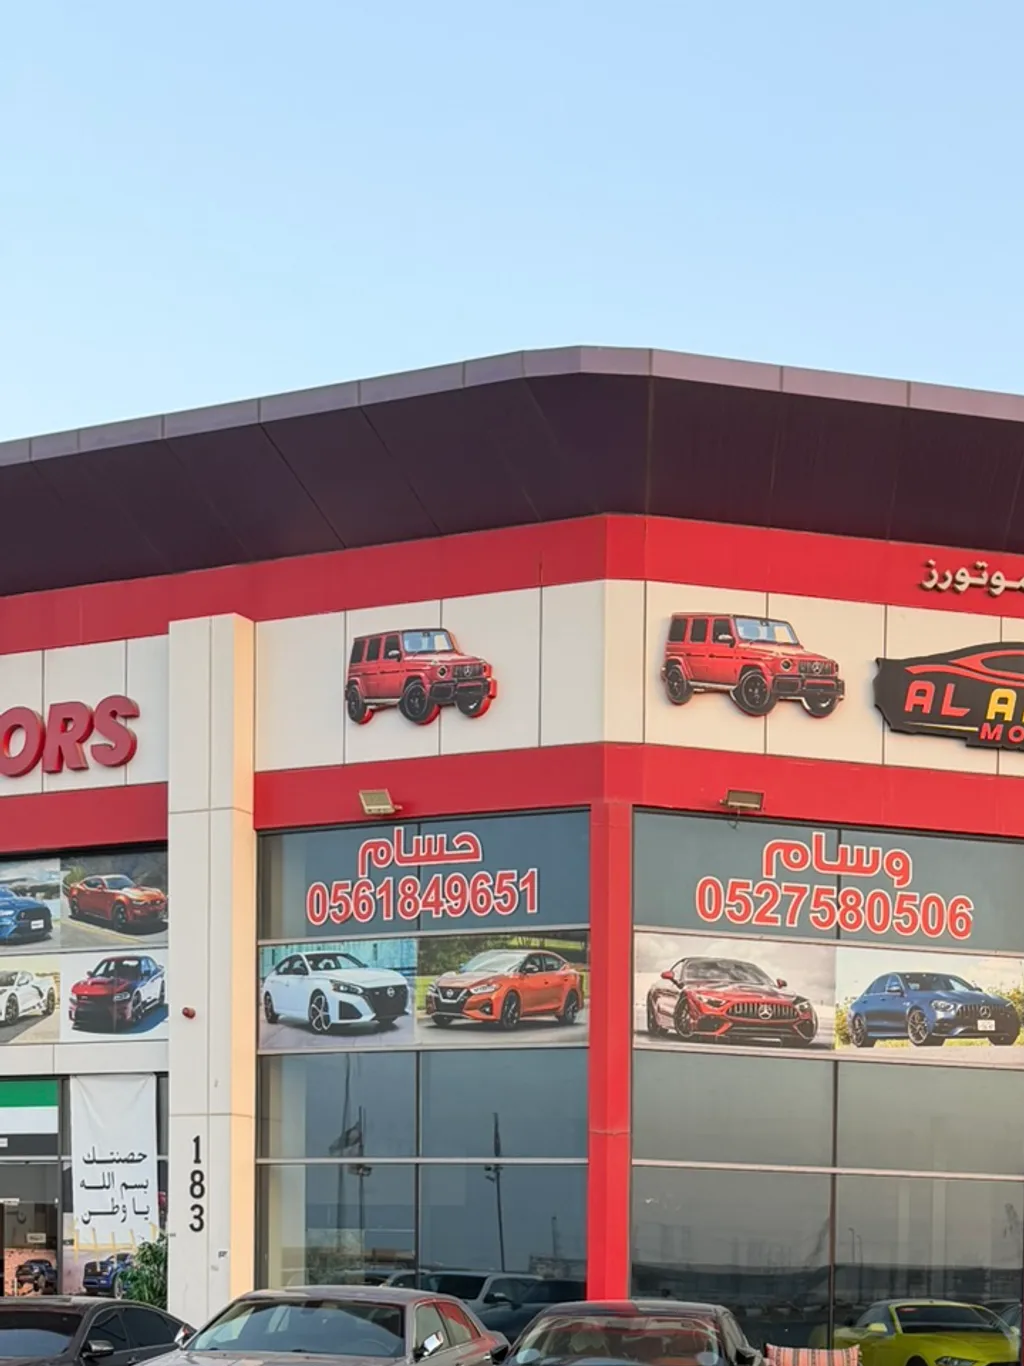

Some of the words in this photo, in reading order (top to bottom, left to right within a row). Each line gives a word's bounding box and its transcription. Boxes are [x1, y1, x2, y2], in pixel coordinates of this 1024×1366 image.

[904, 680, 970, 717] AL
[357, 826, 484, 877] حسام
[762, 832, 913, 887] وسام
[305, 867, 540, 926] 0561849651
[694, 877, 975, 942] 0527580506
[79, 1171, 115, 1190] الله
[120, 1179, 149, 1200] بسم
